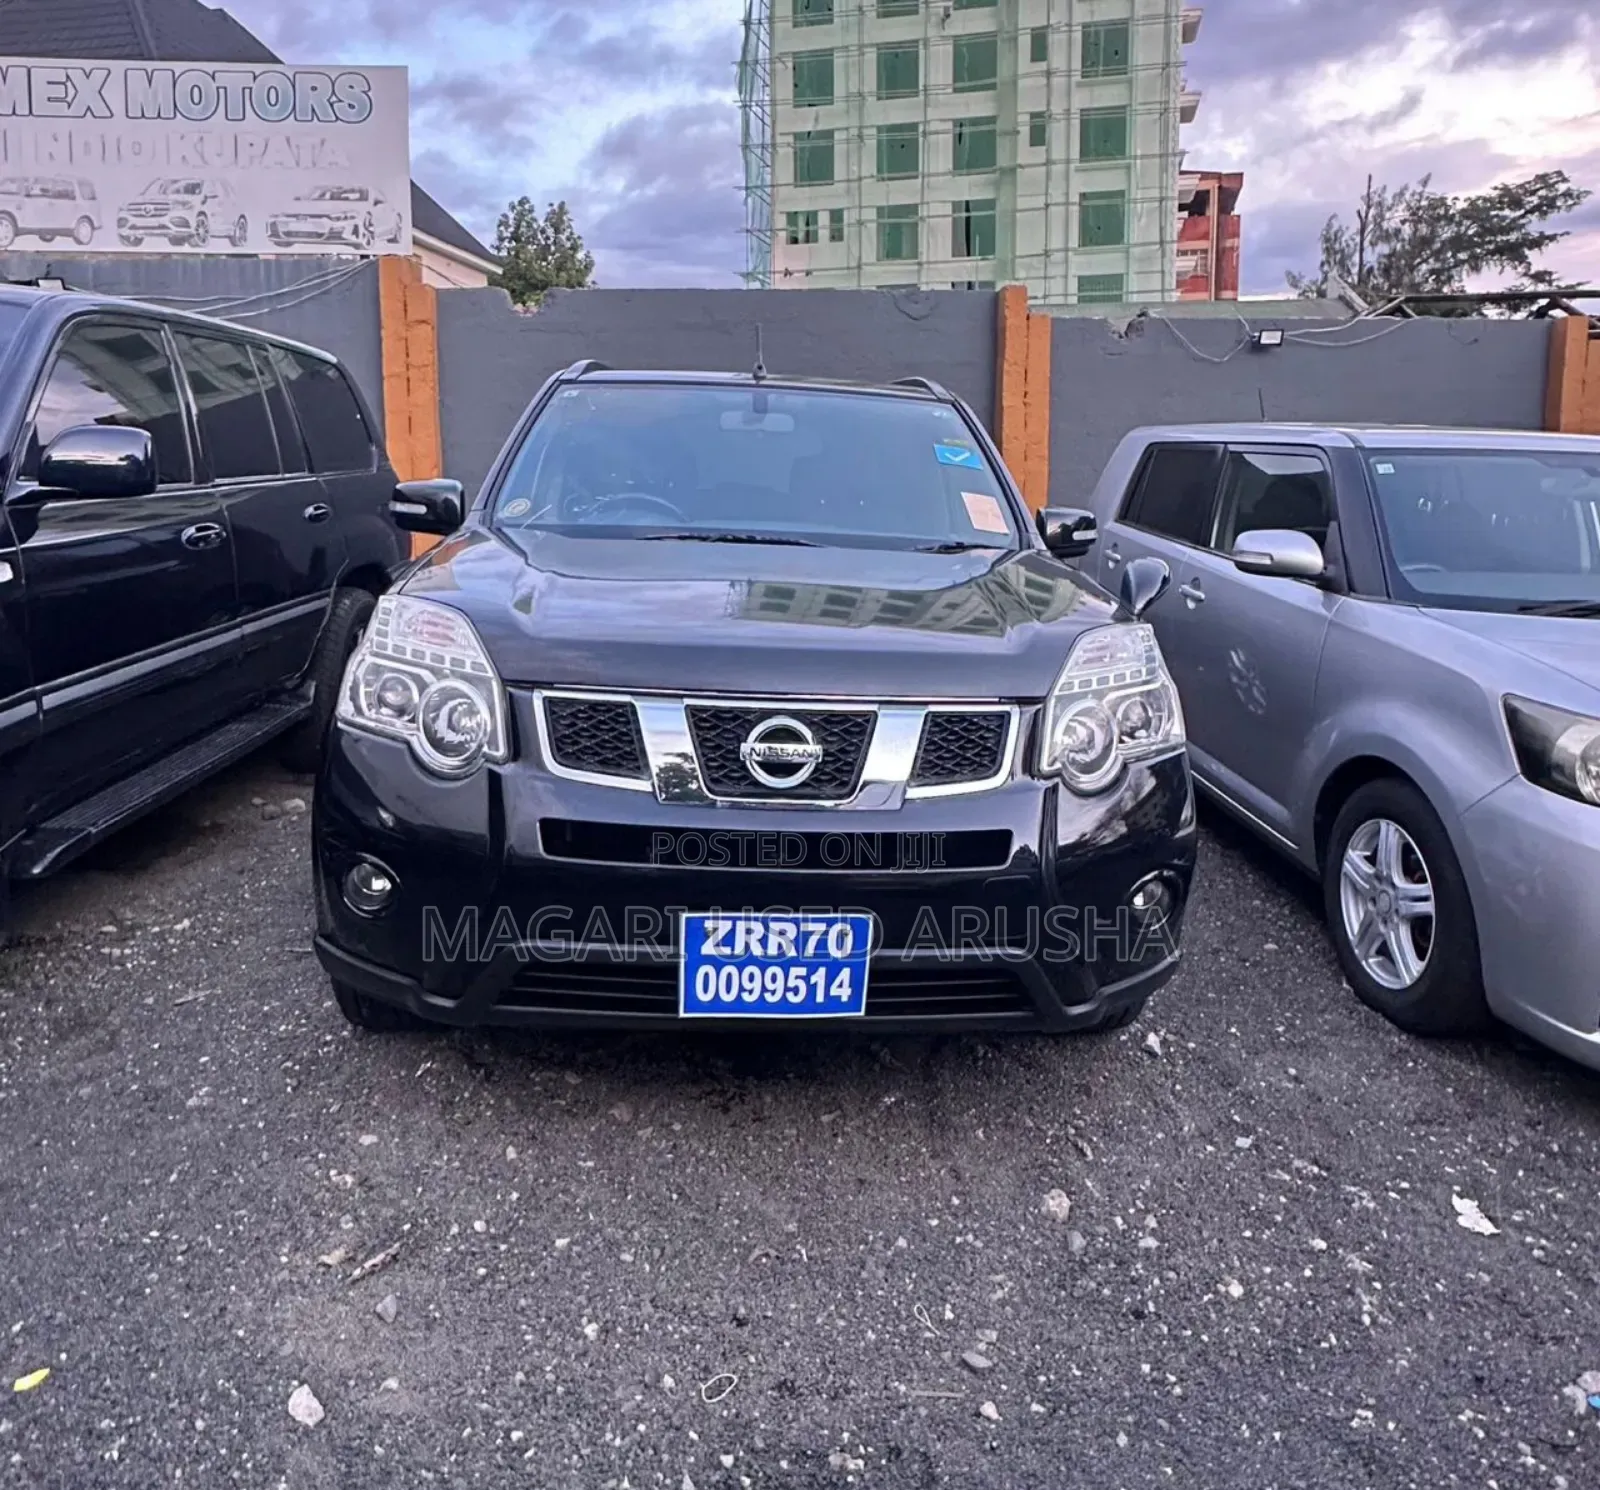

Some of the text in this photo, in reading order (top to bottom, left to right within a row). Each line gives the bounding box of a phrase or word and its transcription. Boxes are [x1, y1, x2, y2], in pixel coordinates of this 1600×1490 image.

[125, 67, 372, 124] MOTORS
[166, 131, 350, 170] KUPATA
[749, 745, 813, 758] NISSAN
[700, 919, 854, 958] ZRR70
[695, 964, 852, 1004] 0099514
